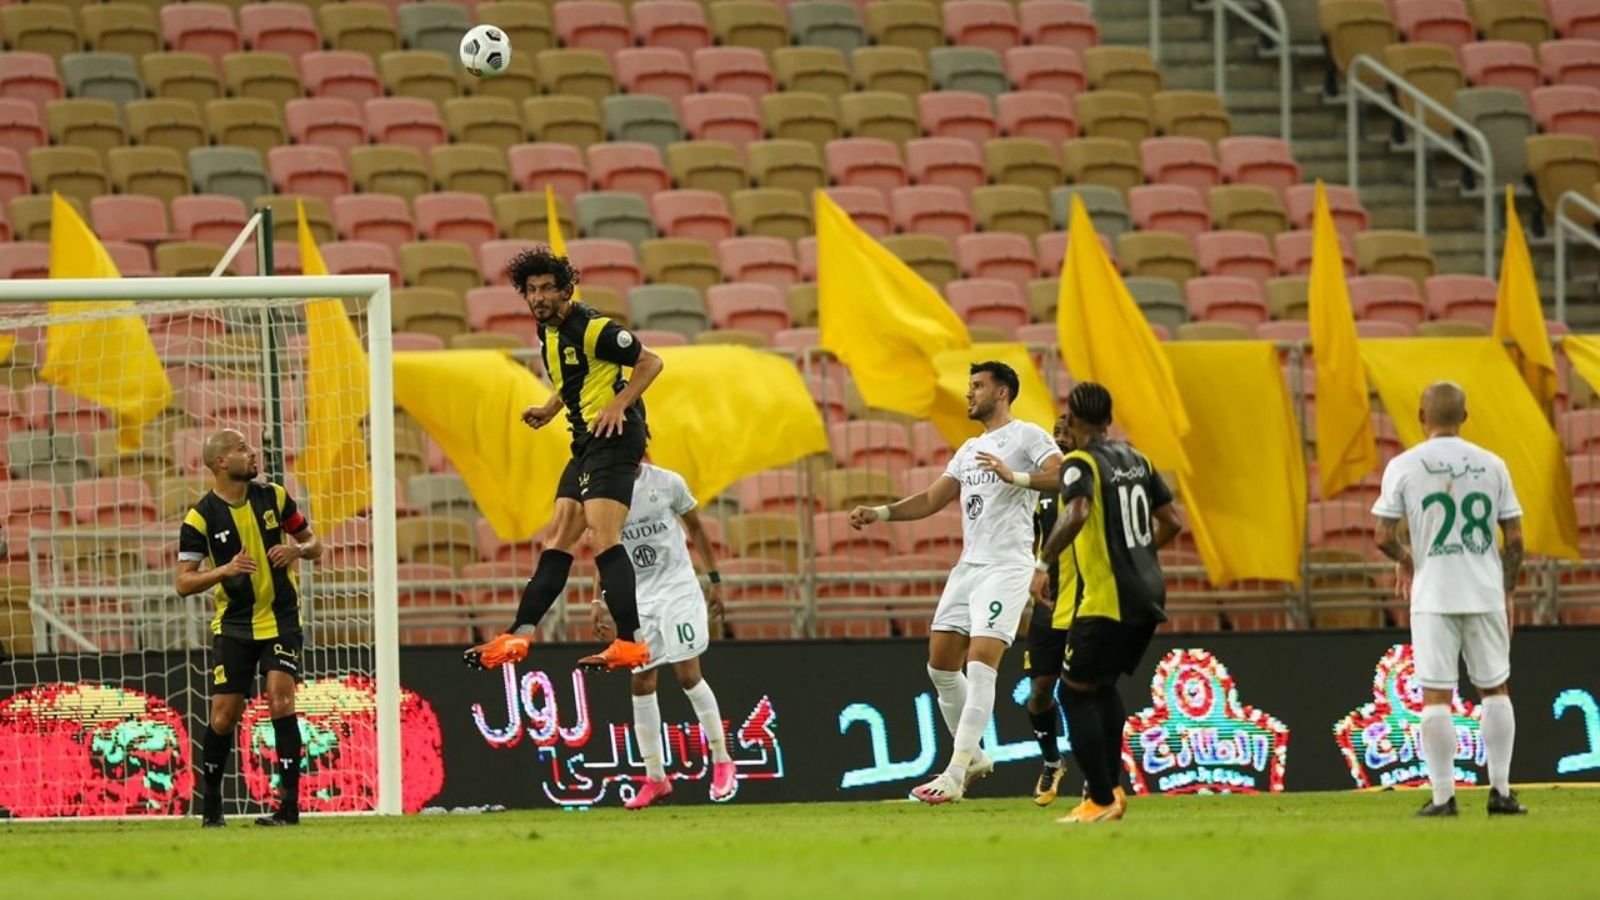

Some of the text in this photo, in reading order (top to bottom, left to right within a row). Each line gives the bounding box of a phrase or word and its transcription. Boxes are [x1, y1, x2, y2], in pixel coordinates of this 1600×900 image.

[961, 472, 1000, 487] AUDI
[1118, 484, 1152, 549] 10
[1421, 491, 1493, 557] 28
[620, 521, 669, 541] AUDIA
[632, 544, 657, 568] MG
[988, 600, 1003, 621] 9
[676, 622, 695, 644] 10
[471, 661, 591, 748] رول
